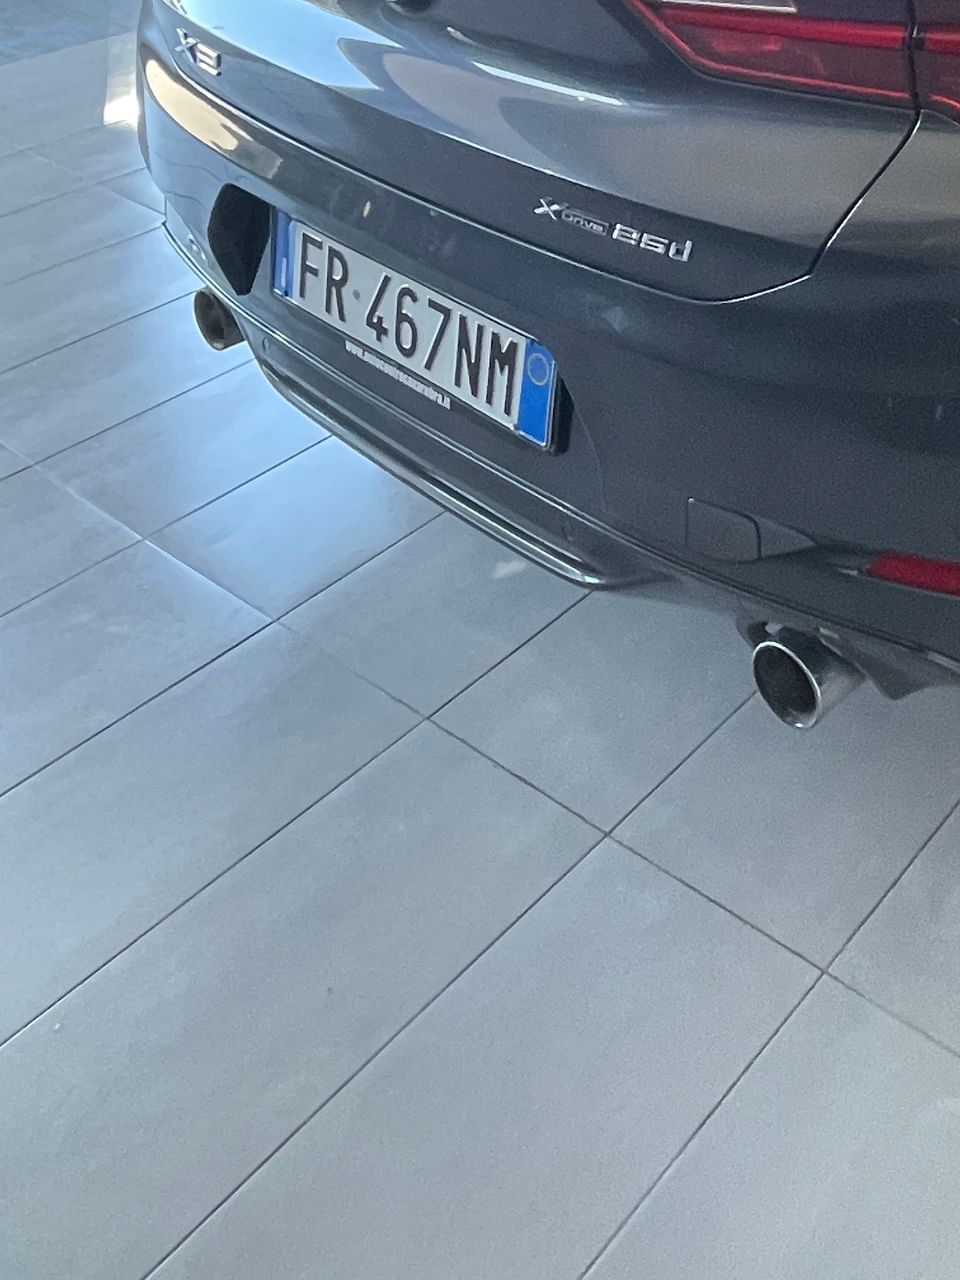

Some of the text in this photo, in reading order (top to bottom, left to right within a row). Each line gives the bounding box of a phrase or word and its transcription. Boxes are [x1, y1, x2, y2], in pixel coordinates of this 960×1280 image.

[611, 222, 694, 263] 25d
[299, 231, 348, 323] FR
[365, 271, 519, 417] 467NM
